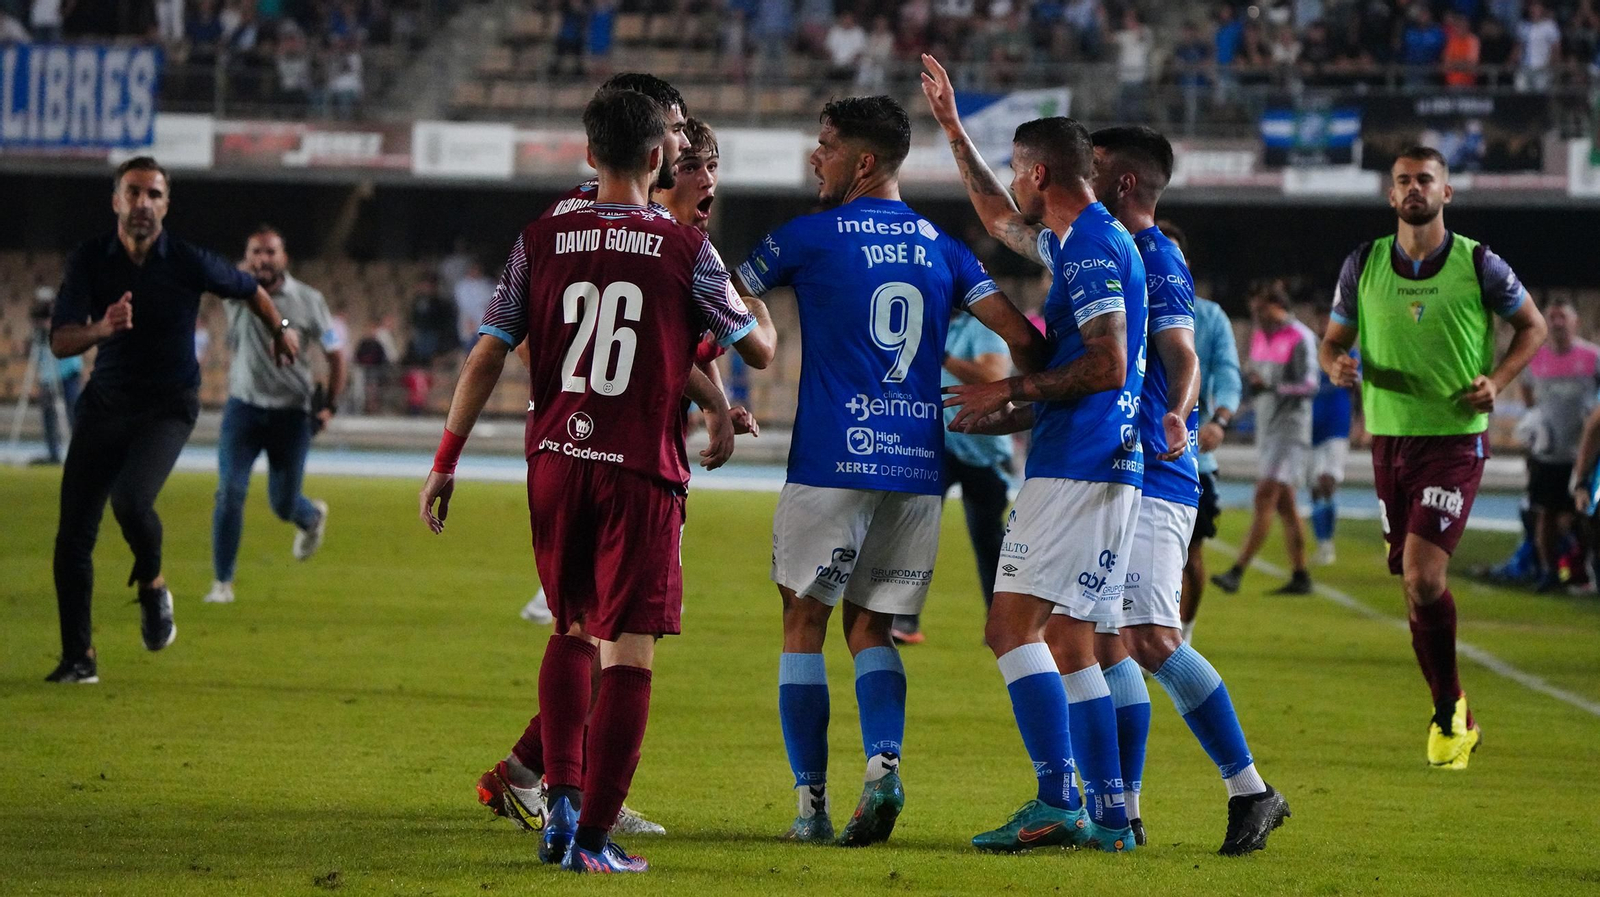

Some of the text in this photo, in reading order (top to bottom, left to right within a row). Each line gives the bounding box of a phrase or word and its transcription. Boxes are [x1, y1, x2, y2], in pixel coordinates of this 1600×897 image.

[2, 45, 157, 142] LIBRES
[837, 217, 916, 235] indeso
[555, 226, 664, 257] DAVID GÓMEZ
[861, 242, 933, 268] JOSÉ R.
[1081, 259, 1118, 270] GIKA
[1397, 286, 1439, 296] macron
[562, 281, 643, 396] 26
[869, 281, 924, 383] 9
[876, 431, 901, 445] High
[563, 442, 624, 463] Cadenas
[876, 443, 935, 459] ProNutrition
[835, 461, 939, 482] XEREZ DEPORTIVO
